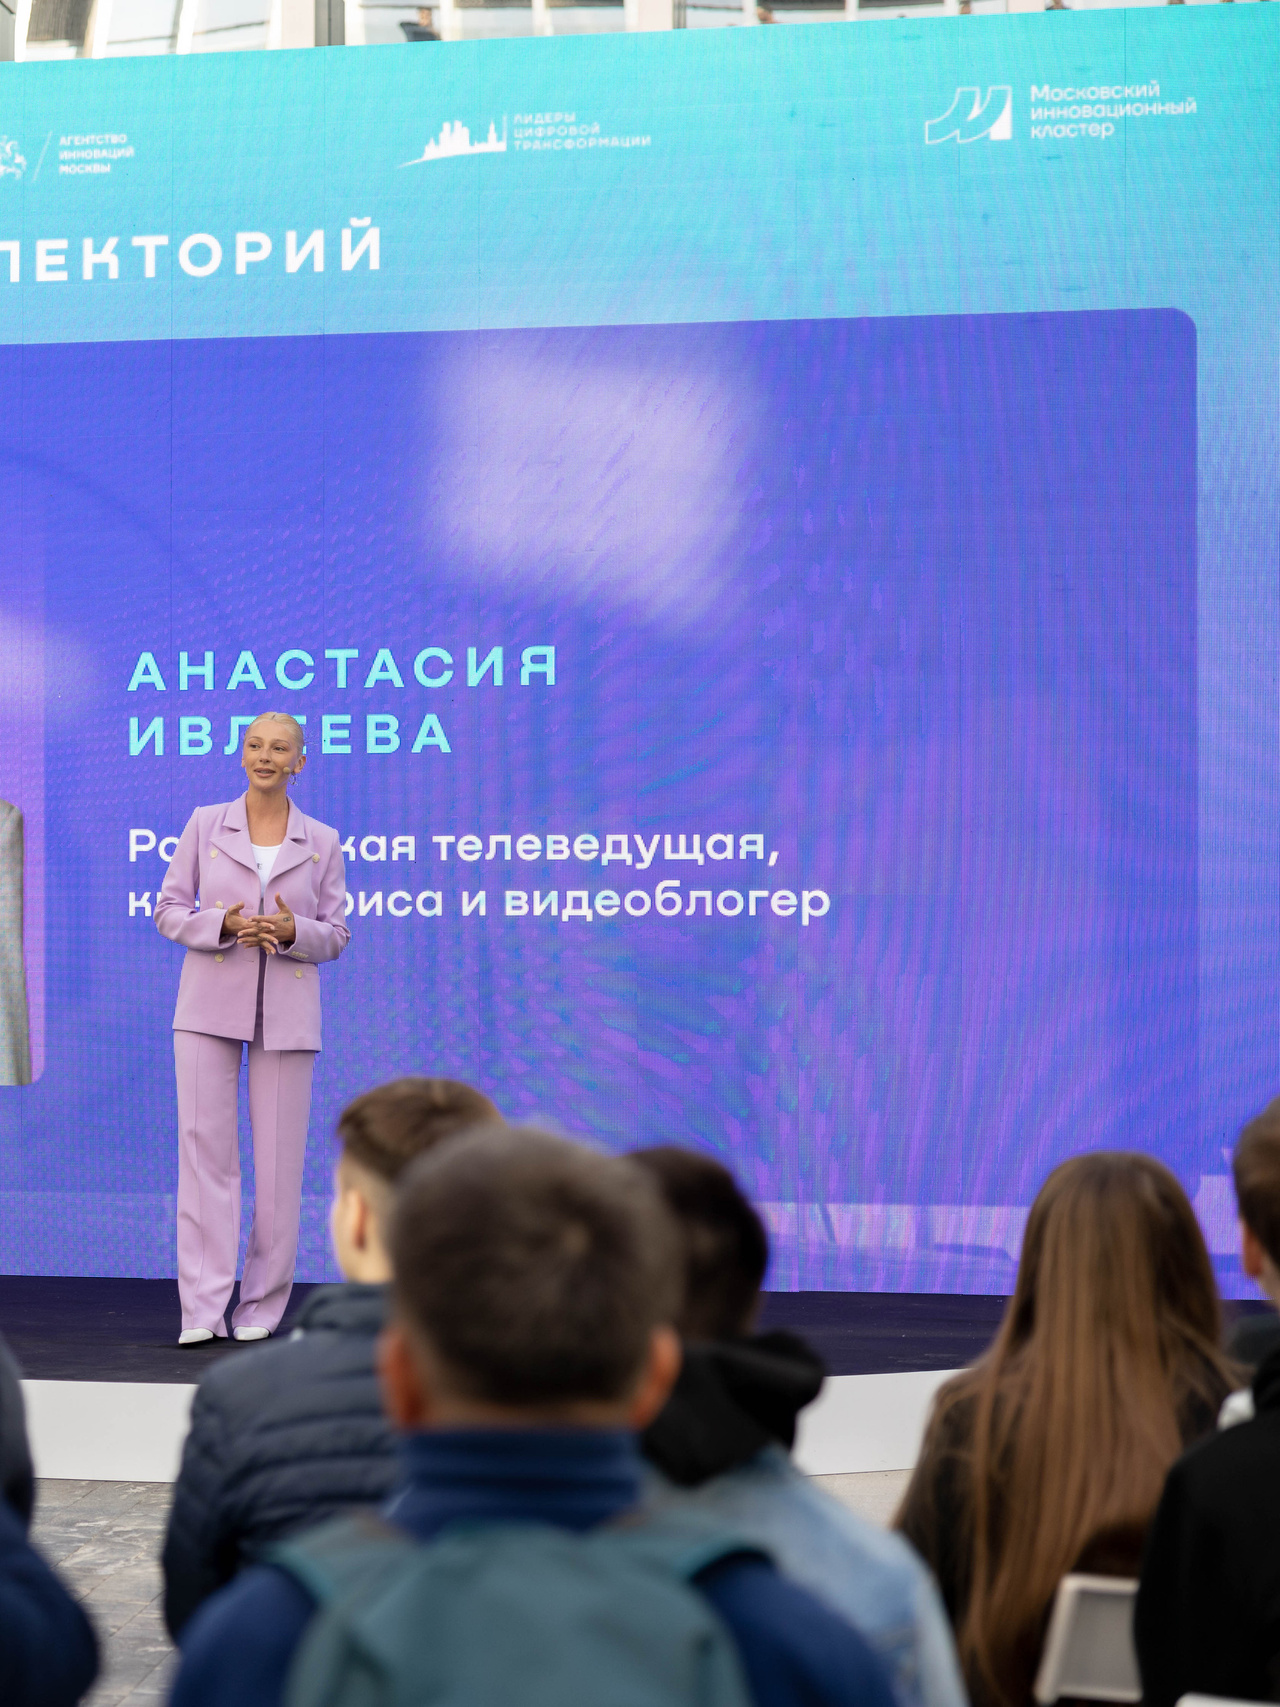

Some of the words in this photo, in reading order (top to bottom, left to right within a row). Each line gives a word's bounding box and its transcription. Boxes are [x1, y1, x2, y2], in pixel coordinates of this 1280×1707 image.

[1031, 80, 1161, 101] Московский
[514, 112, 576, 124] ЛИДЕРЫ
[1031, 98, 1197, 120] инновационный
[514, 122, 600, 138] ЦИФРОВОЙ
[1030, 121, 1115, 139] кластер
[60, 134, 127, 146] АГЕНТСТВО
[514, 135, 651, 150] ТРАНСФОРМАЦИИ
[59, 146, 134, 160] ИННОВАЦИЙ
[59, 163, 111, 174] МОСКВЫ
[127, 645, 557, 692] АНАСТАСИЯ
[128, 713, 452, 757] ИВЛЕВА
[432, 832, 780, 869] телеведущая,
[461, 891, 487, 916] и
[505, 880, 831, 926] видеоблогер
